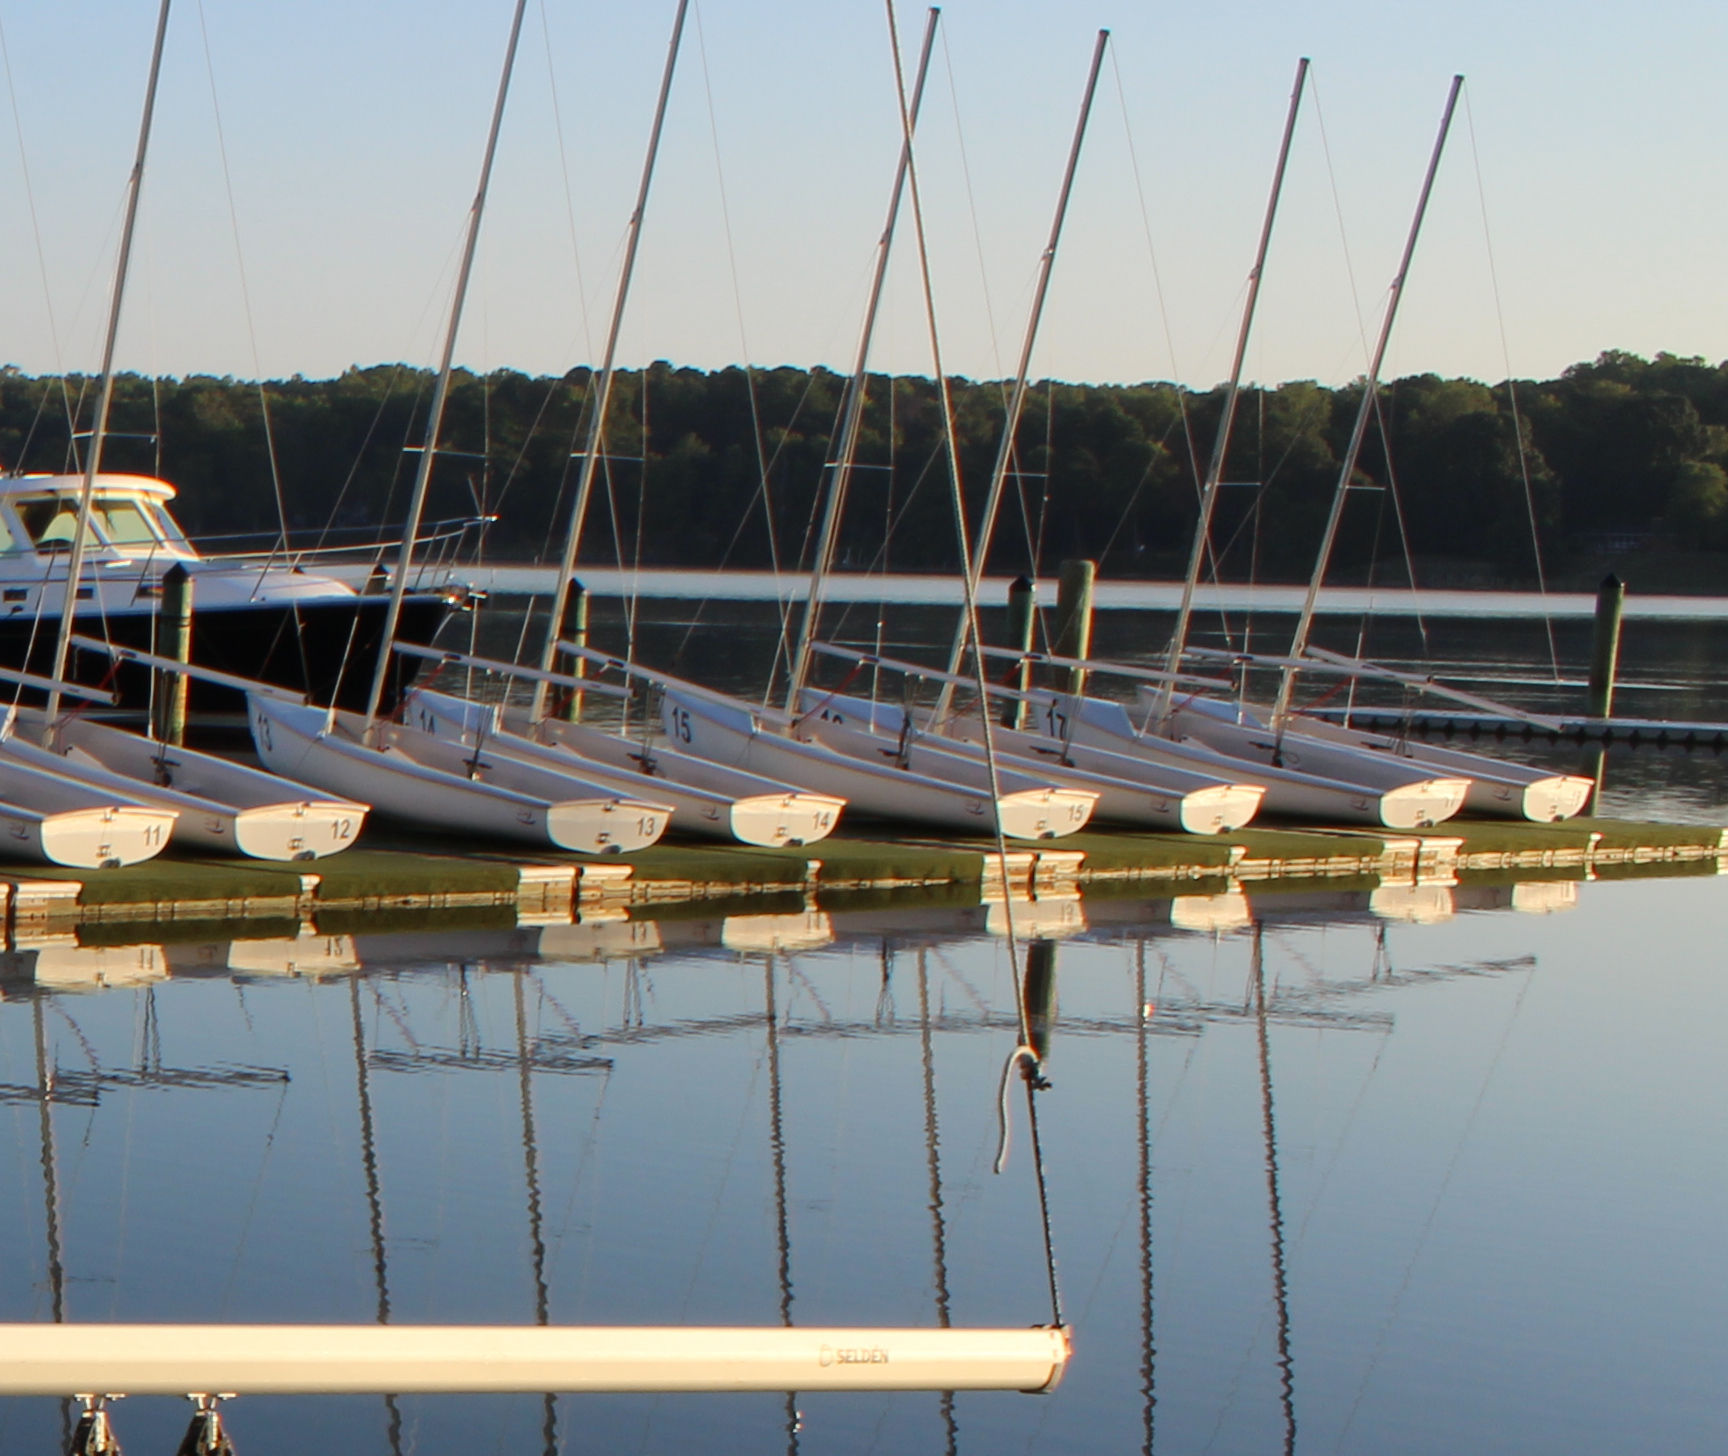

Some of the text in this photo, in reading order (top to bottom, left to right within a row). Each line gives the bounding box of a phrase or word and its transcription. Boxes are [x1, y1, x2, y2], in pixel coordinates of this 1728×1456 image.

[672, 706, 692, 744] 15
[1046, 707, 1068, 741] 17
[813, 811, 830, 830] 14
[1068, 804, 1084, 822] 15
[143, 824, 162, 847] 11
[331, 818, 352, 840] 12
[636, 816, 655, 837] 13
[837, 1346, 888, 1364] SELDÉN
